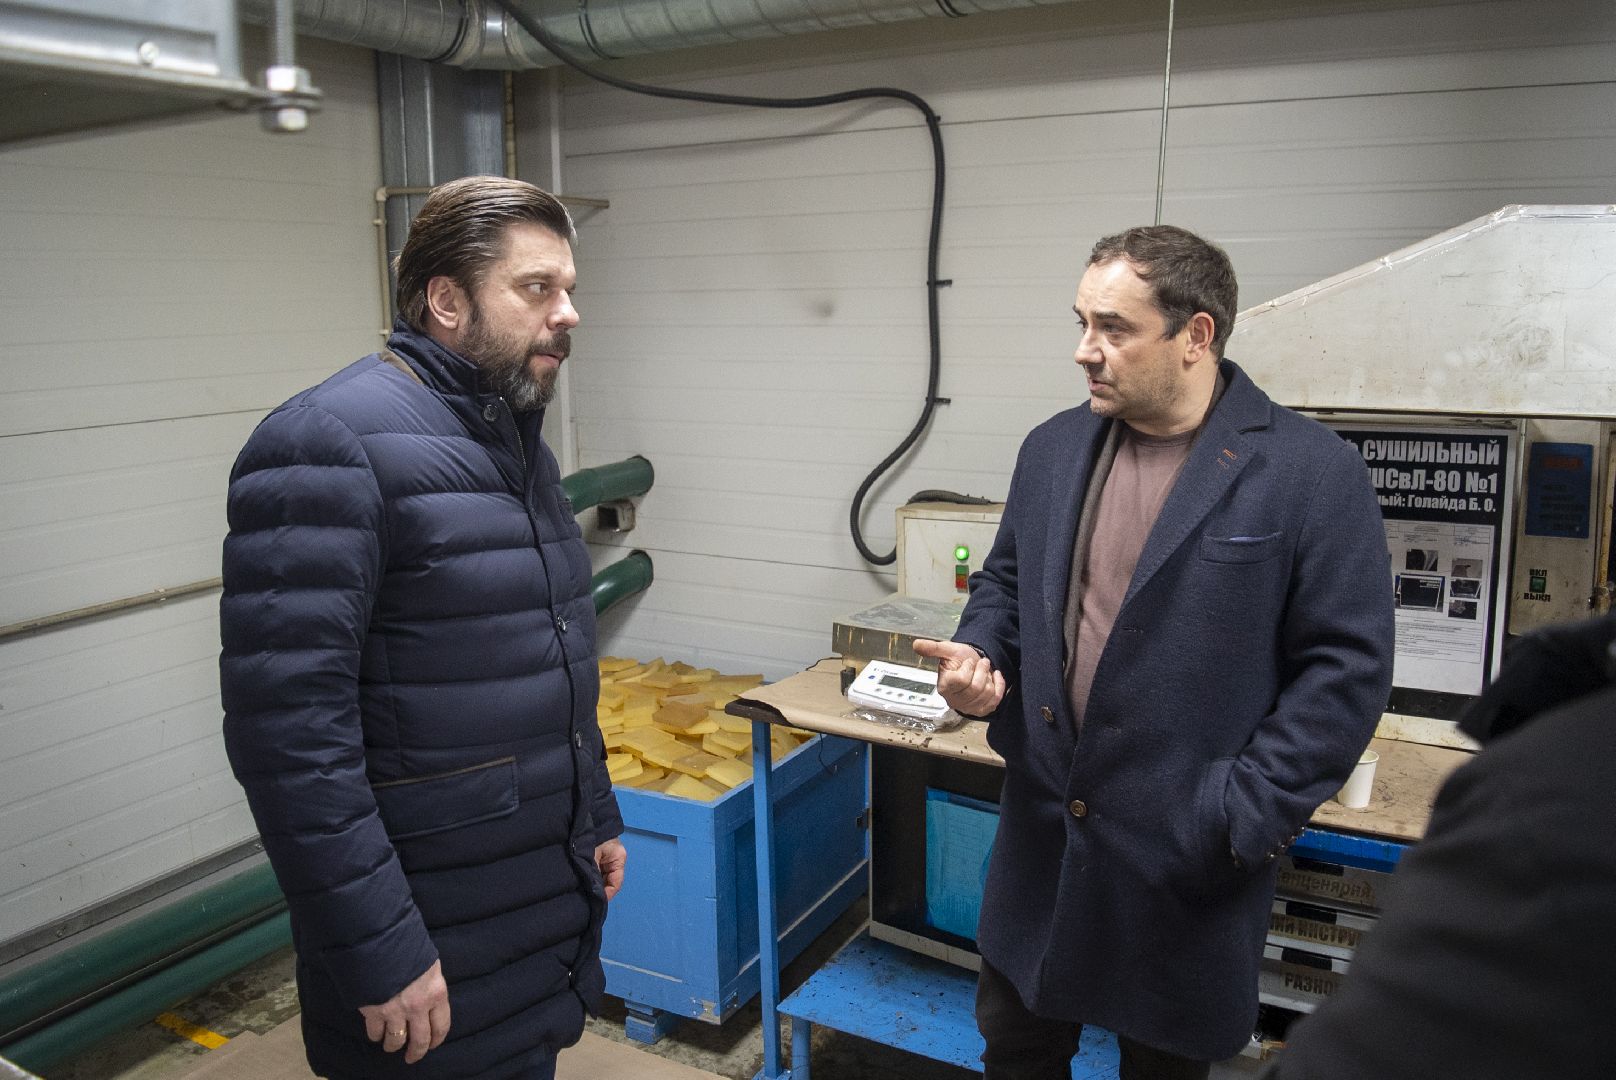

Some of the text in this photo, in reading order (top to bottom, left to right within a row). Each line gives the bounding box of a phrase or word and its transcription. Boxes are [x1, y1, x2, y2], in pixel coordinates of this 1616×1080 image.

[1362, 439, 1500, 465] СУШИЛЬНЫЙ
[1465, 470, 1498, 494] №1
[1407, 494, 1467, 512] Голайда
[1468, 498, 1481, 511] Б.
[1484, 498, 1496, 512] О.
[1529, 568, 1548, 577] ВКЛ
[1523, 592, 1552, 603] ВЫКЛ
[1298, 920, 1361, 947] ИНСТРУ
